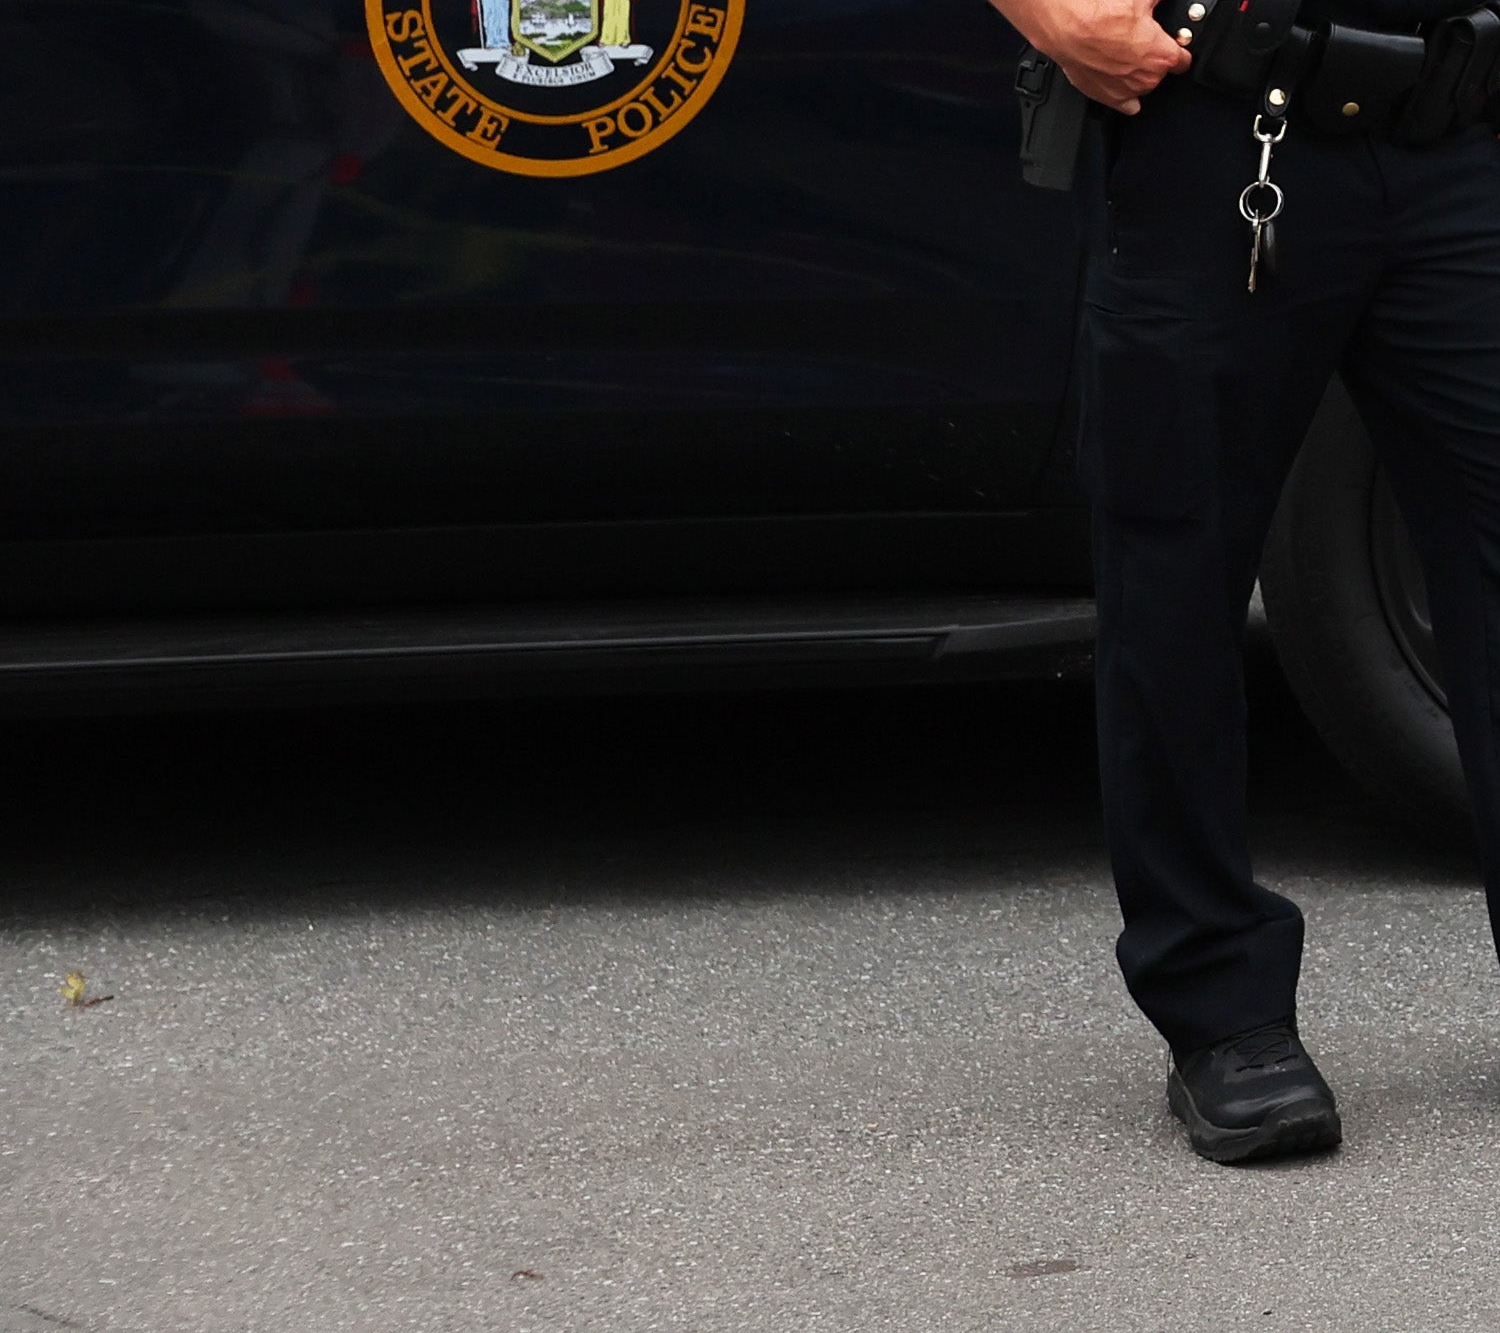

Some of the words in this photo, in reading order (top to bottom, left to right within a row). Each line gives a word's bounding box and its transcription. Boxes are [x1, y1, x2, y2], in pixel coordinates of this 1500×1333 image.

[387, 9, 510, 150] STATE
[581, 2, 727, 154] POLICE
[514, 60, 593, 79] EXCELSIOR
